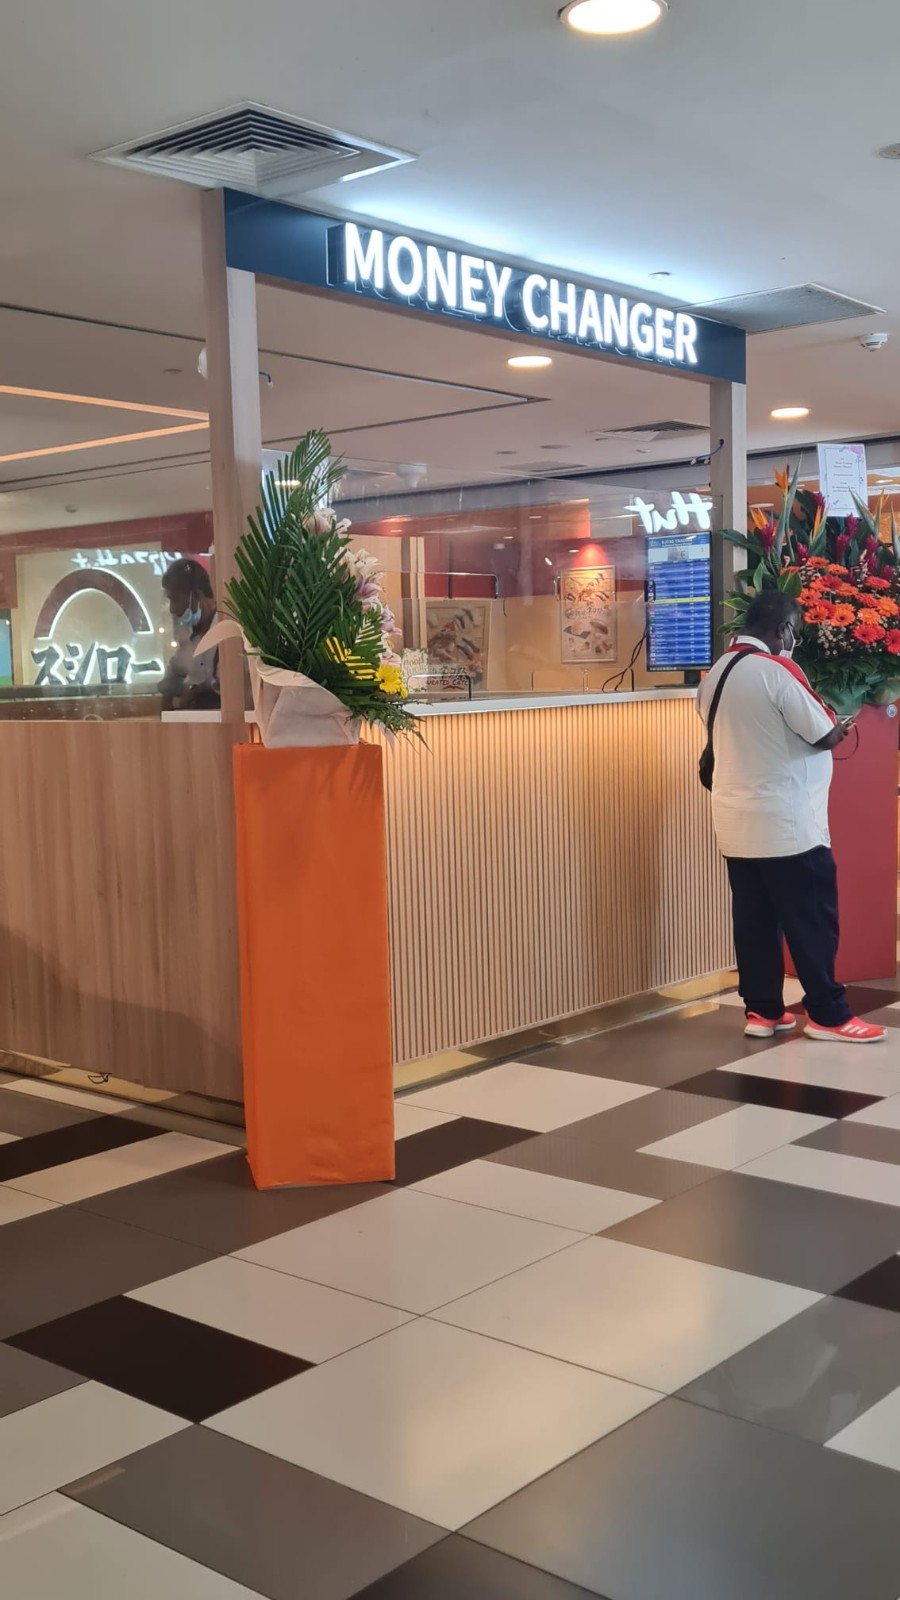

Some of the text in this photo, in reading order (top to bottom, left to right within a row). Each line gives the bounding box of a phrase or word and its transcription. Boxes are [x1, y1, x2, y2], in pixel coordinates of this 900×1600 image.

[344, 222, 699, 364] MONEY CHANGER
[31, 641, 166, 686] スシロー
